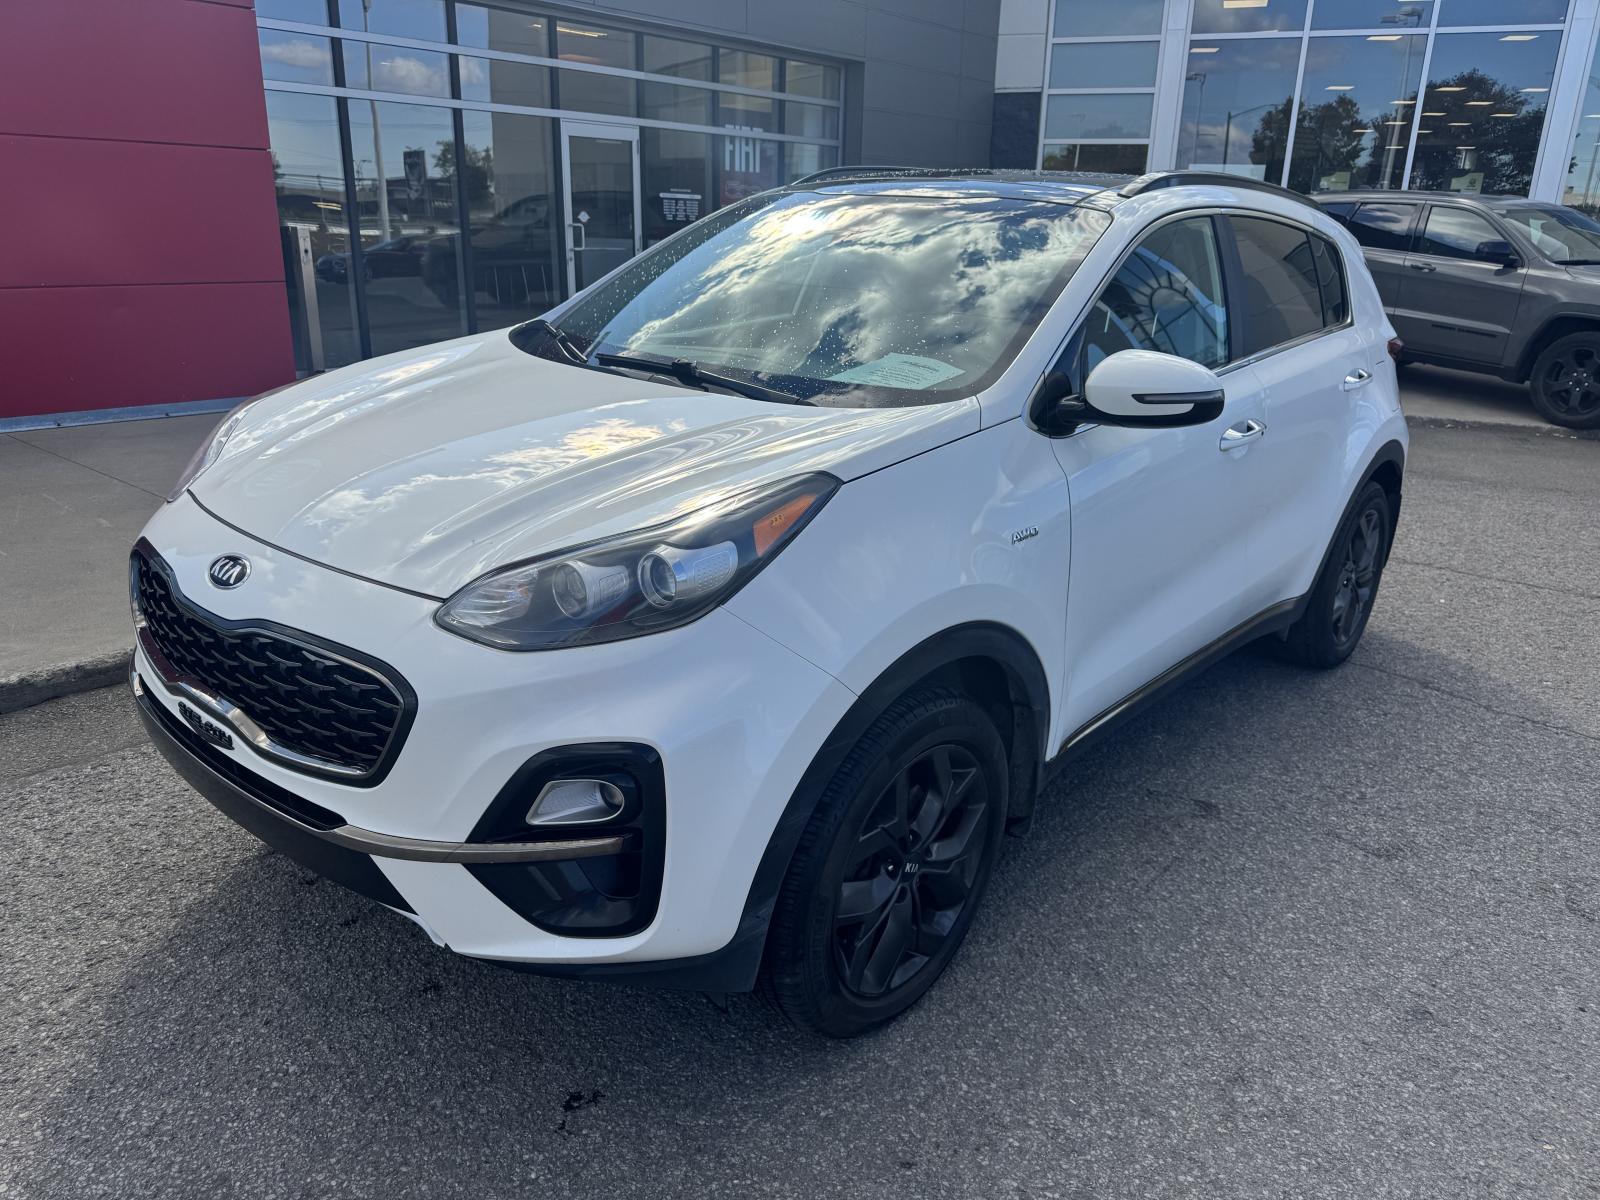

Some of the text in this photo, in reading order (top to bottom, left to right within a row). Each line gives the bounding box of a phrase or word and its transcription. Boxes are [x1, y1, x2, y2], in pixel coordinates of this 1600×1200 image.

[724, 123, 764, 174] FIAT
[1011, 526, 1039, 545] AWD
[210, 557, 242, 584] KIA
[904, 862, 919, 873] KIA
